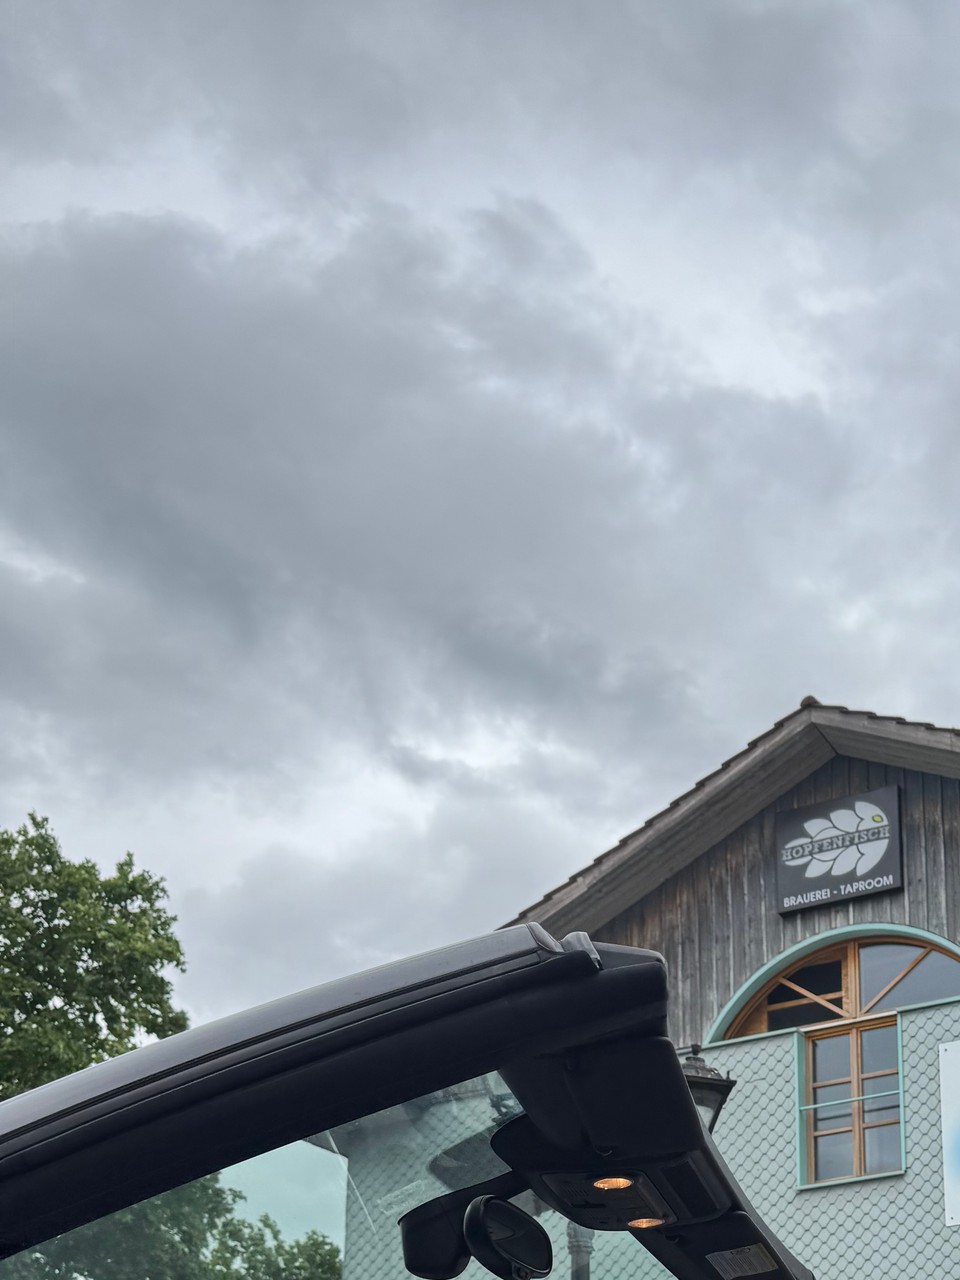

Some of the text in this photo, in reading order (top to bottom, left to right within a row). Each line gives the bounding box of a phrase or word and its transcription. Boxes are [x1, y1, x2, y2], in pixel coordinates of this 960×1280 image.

[782, 825, 890, 861] HOPFENFISCH
[783, 888, 831, 908] BRAUEREI
[840, 874, 893, 895] TAPROOM
